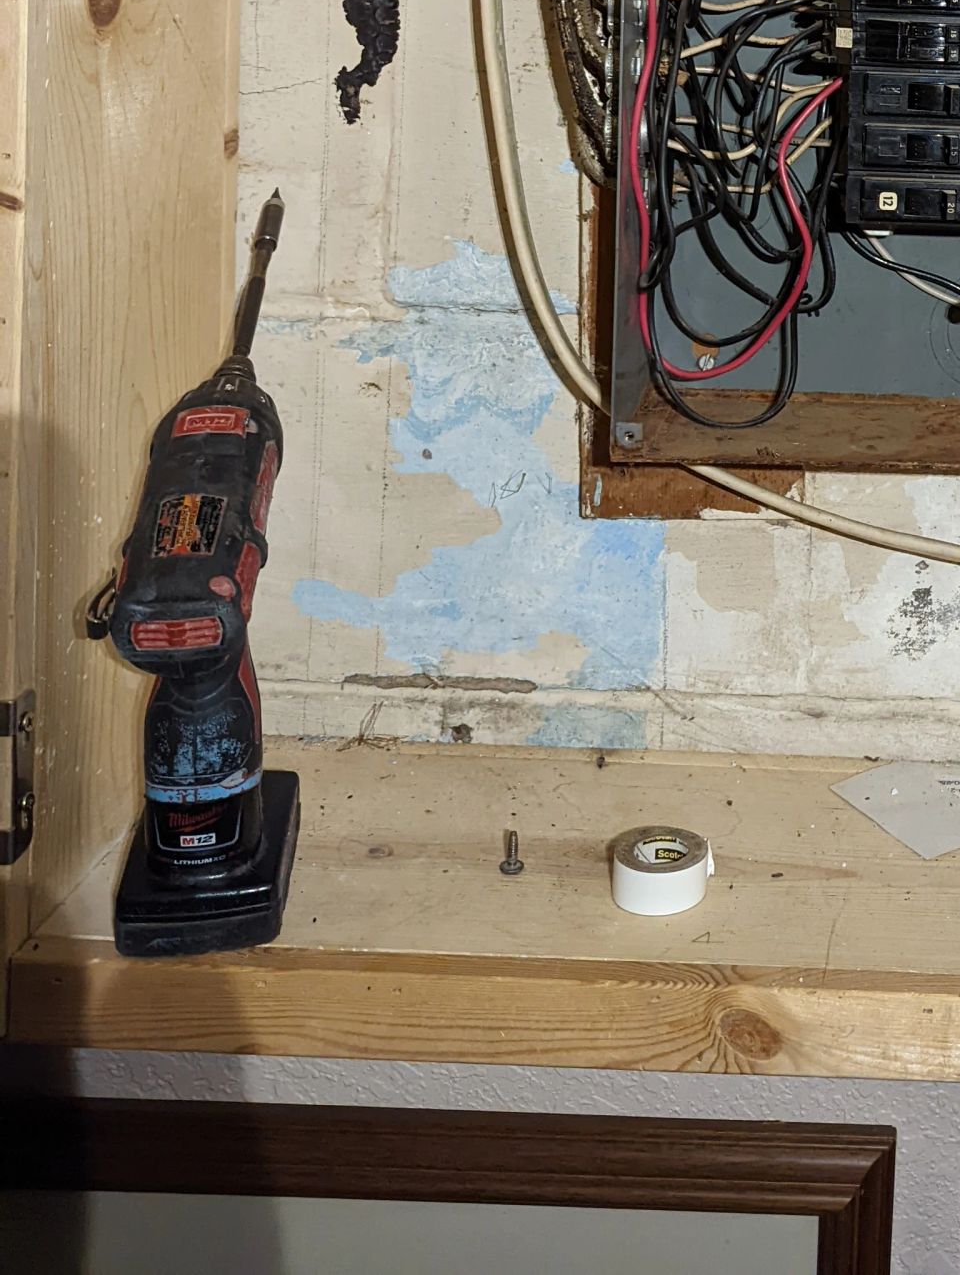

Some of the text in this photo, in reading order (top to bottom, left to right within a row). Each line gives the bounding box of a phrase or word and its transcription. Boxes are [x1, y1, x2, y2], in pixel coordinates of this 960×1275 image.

[951, 145, 959, 157] 15
[882, 196, 894, 207] 12
[947, 202, 956, 214] 20
[182, 835, 214, 845] M12
[173, 857, 213, 865] LITHIUM
